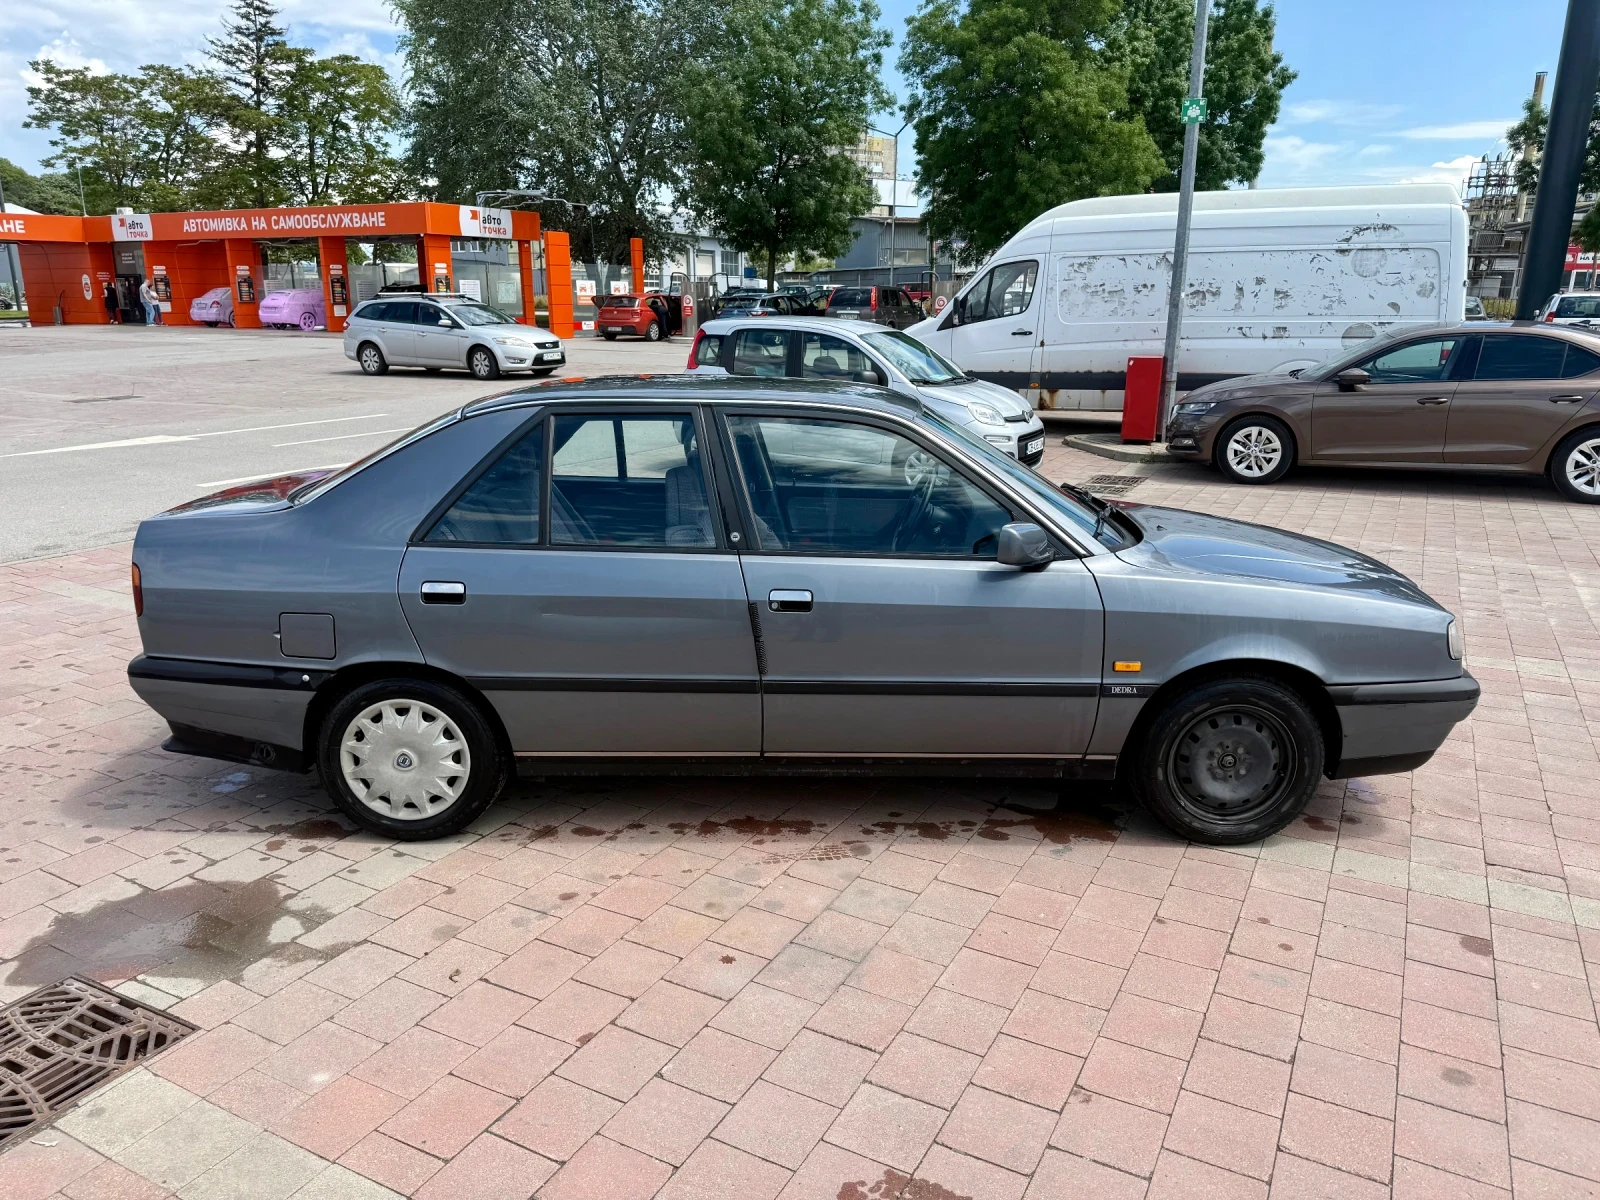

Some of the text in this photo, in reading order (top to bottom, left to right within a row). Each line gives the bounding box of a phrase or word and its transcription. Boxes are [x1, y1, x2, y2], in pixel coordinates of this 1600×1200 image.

[128, 220, 144, 230] авто
[183, 211, 386, 233] АВТОМИВКА НА САМООБСЛУЖВАНЕ
[482, 214, 502, 226] авто
[129, 230, 149, 239] точка
[482, 226, 507, 236] точка
